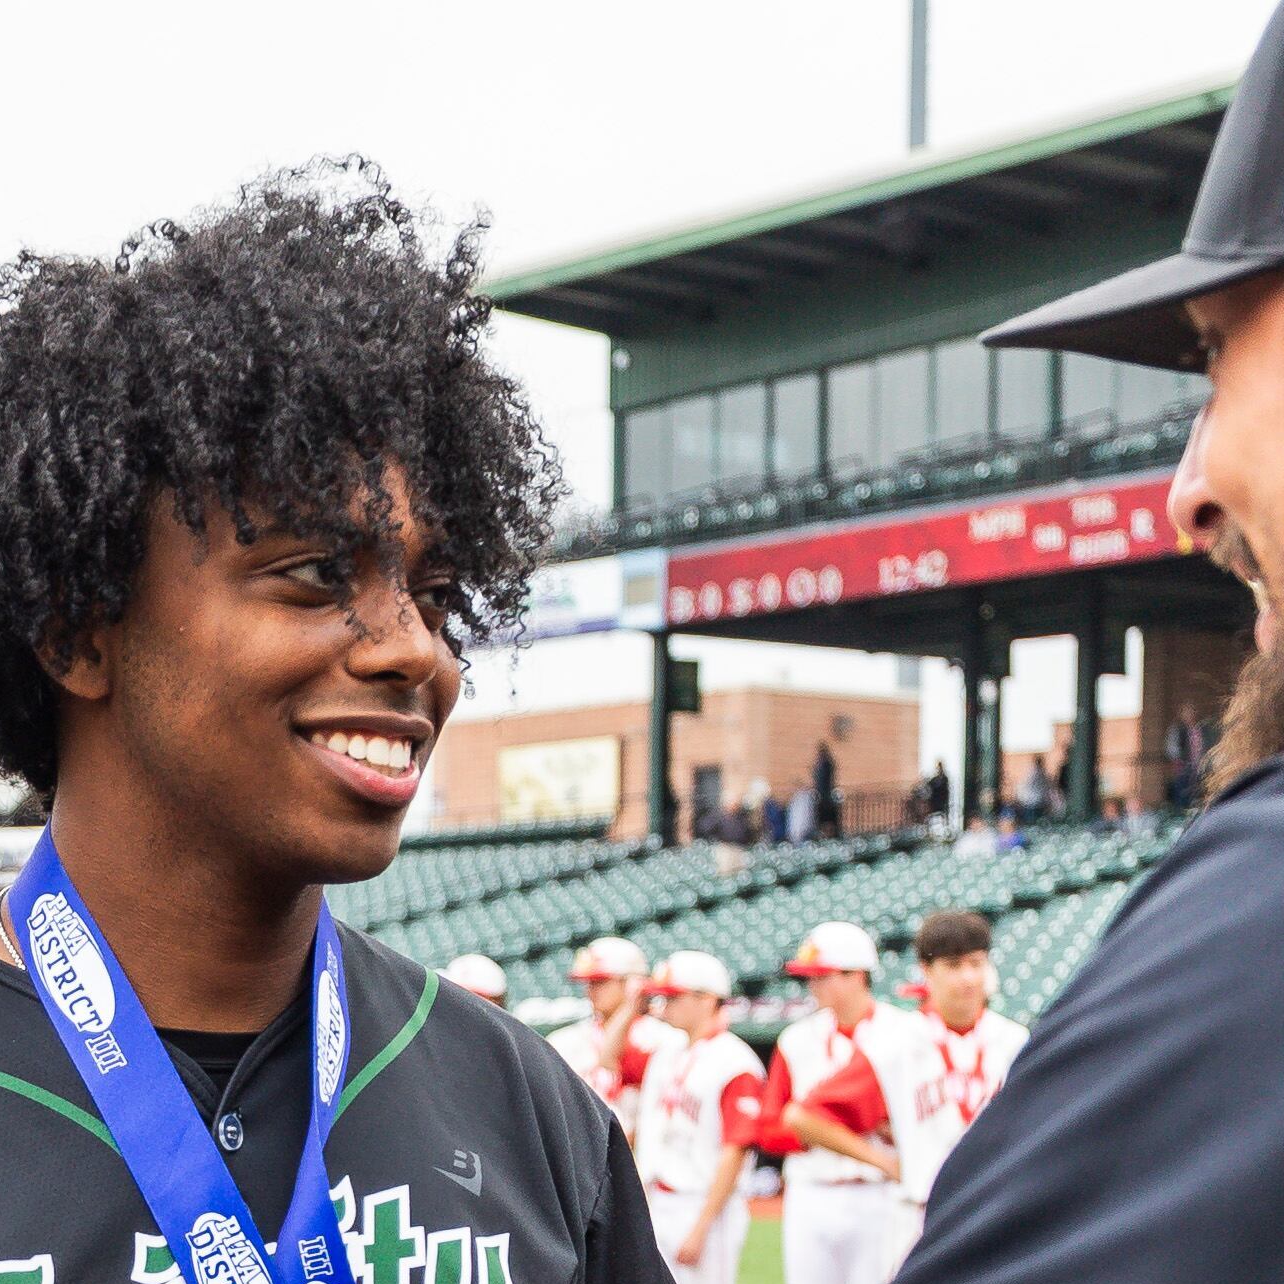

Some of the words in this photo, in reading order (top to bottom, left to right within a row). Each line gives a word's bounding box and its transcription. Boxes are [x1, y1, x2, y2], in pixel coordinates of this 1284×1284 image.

[48, 892, 89, 956] PIAA
[27, 908, 103, 1031] DISTRICT
[85, 1030, 128, 1075] III
[217, 1215, 264, 1284] PIAA
[298, 1236, 333, 1279] III
